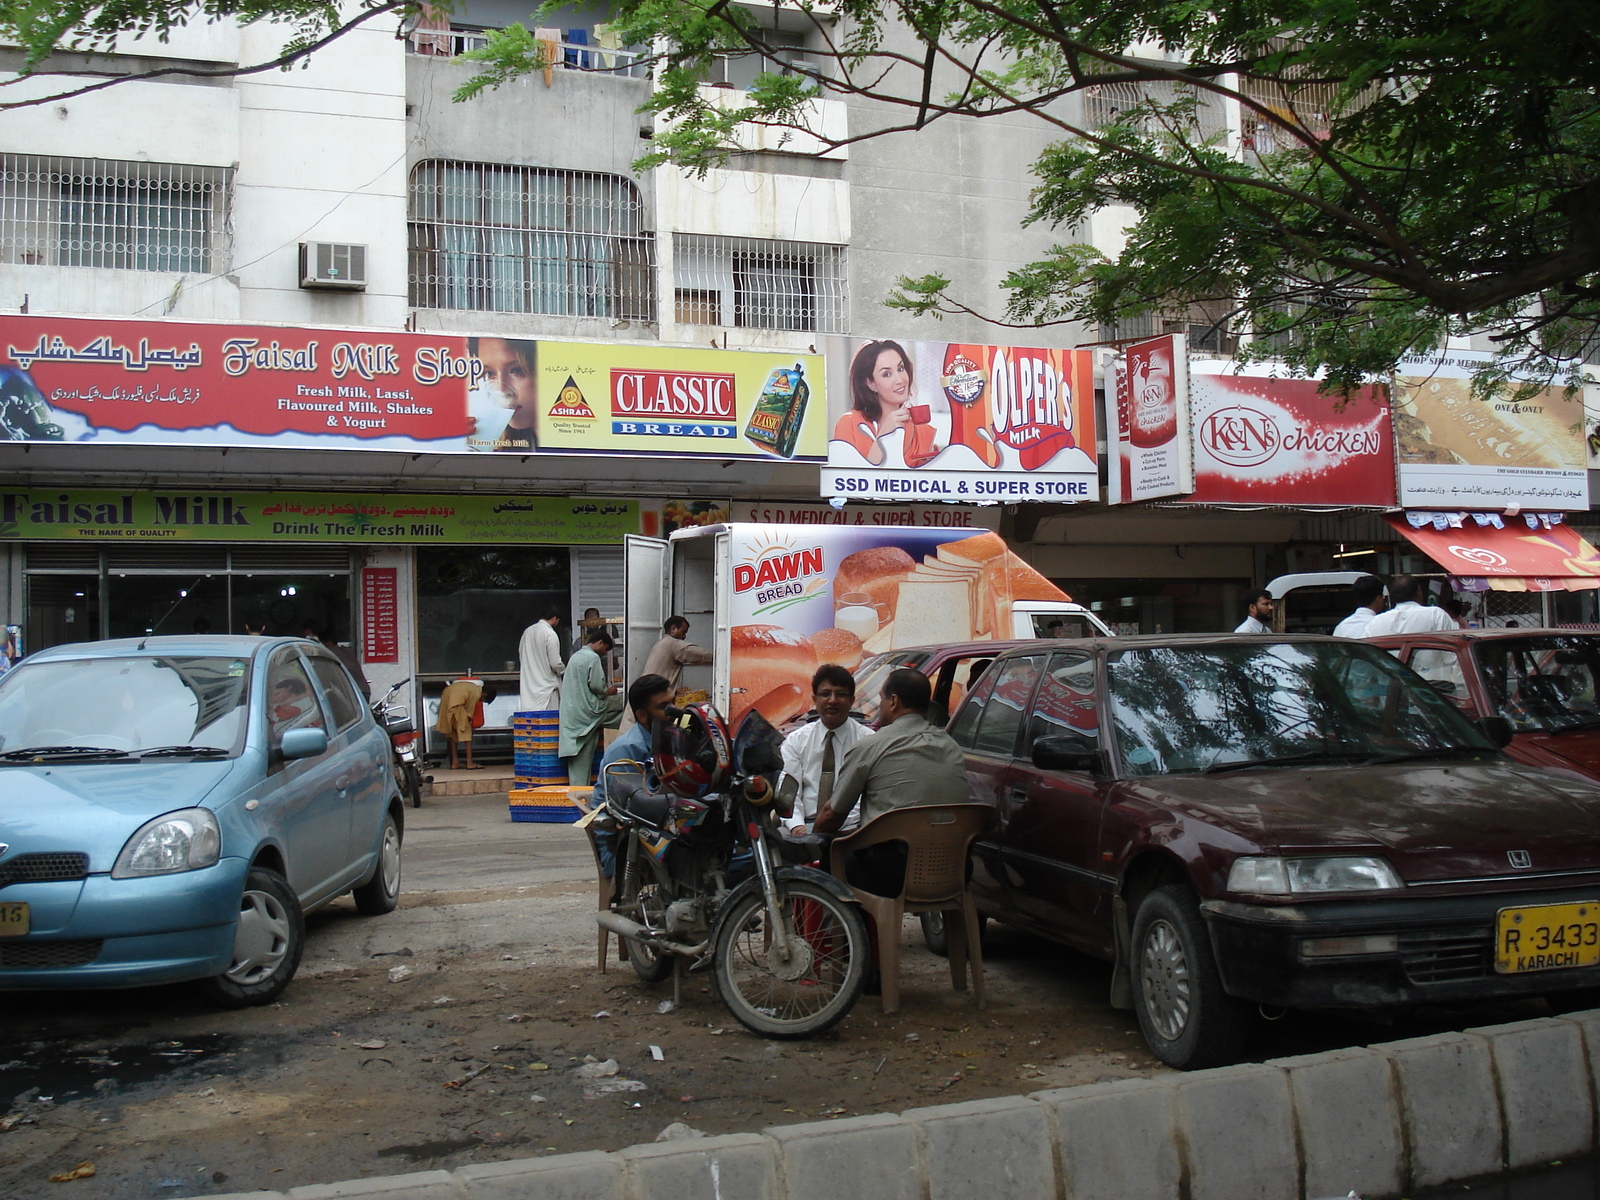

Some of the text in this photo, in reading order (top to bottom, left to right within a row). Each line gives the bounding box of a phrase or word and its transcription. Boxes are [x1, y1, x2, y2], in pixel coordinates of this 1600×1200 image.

[8, 334, 201, 371] فیصل ملک شاپ
[222, 338, 483, 391] Faisal Milk Shop
[297, 385, 414, 401] Fresh Milk, Lassi,
[616, 374, 731, 415] CLASSIC
[277, 399, 433, 415] Flavoured Milk, Shakes
[550, 408, 593, 417] ASHRAFI
[1495, 404, 1511, 412] ONE
[1512, 403, 1520, 414] &
[326, 415, 386, 430] & Yogurt
[620, 423, 730, 437] BREAD
[752, 413, 780, 430] CLASSIC
[1009, 427, 1041, 444] MILK
[1210, 416, 1275, 452] K&N's
[835, 478, 1088, 495] SSD MEDICAL & SUPER STORE
[1, 494, 251, 525] Faisal Milk
[923, 511, 972, 527] STORE
[139, 529, 177, 537] QUALITY
[272, 522, 445, 536] Drink The Fresh Milk
[734, 547, 823, 593] DAWN
[757, 583, 803, 604] BREAD
[1517, 952, 1580, 970] KARACHI
